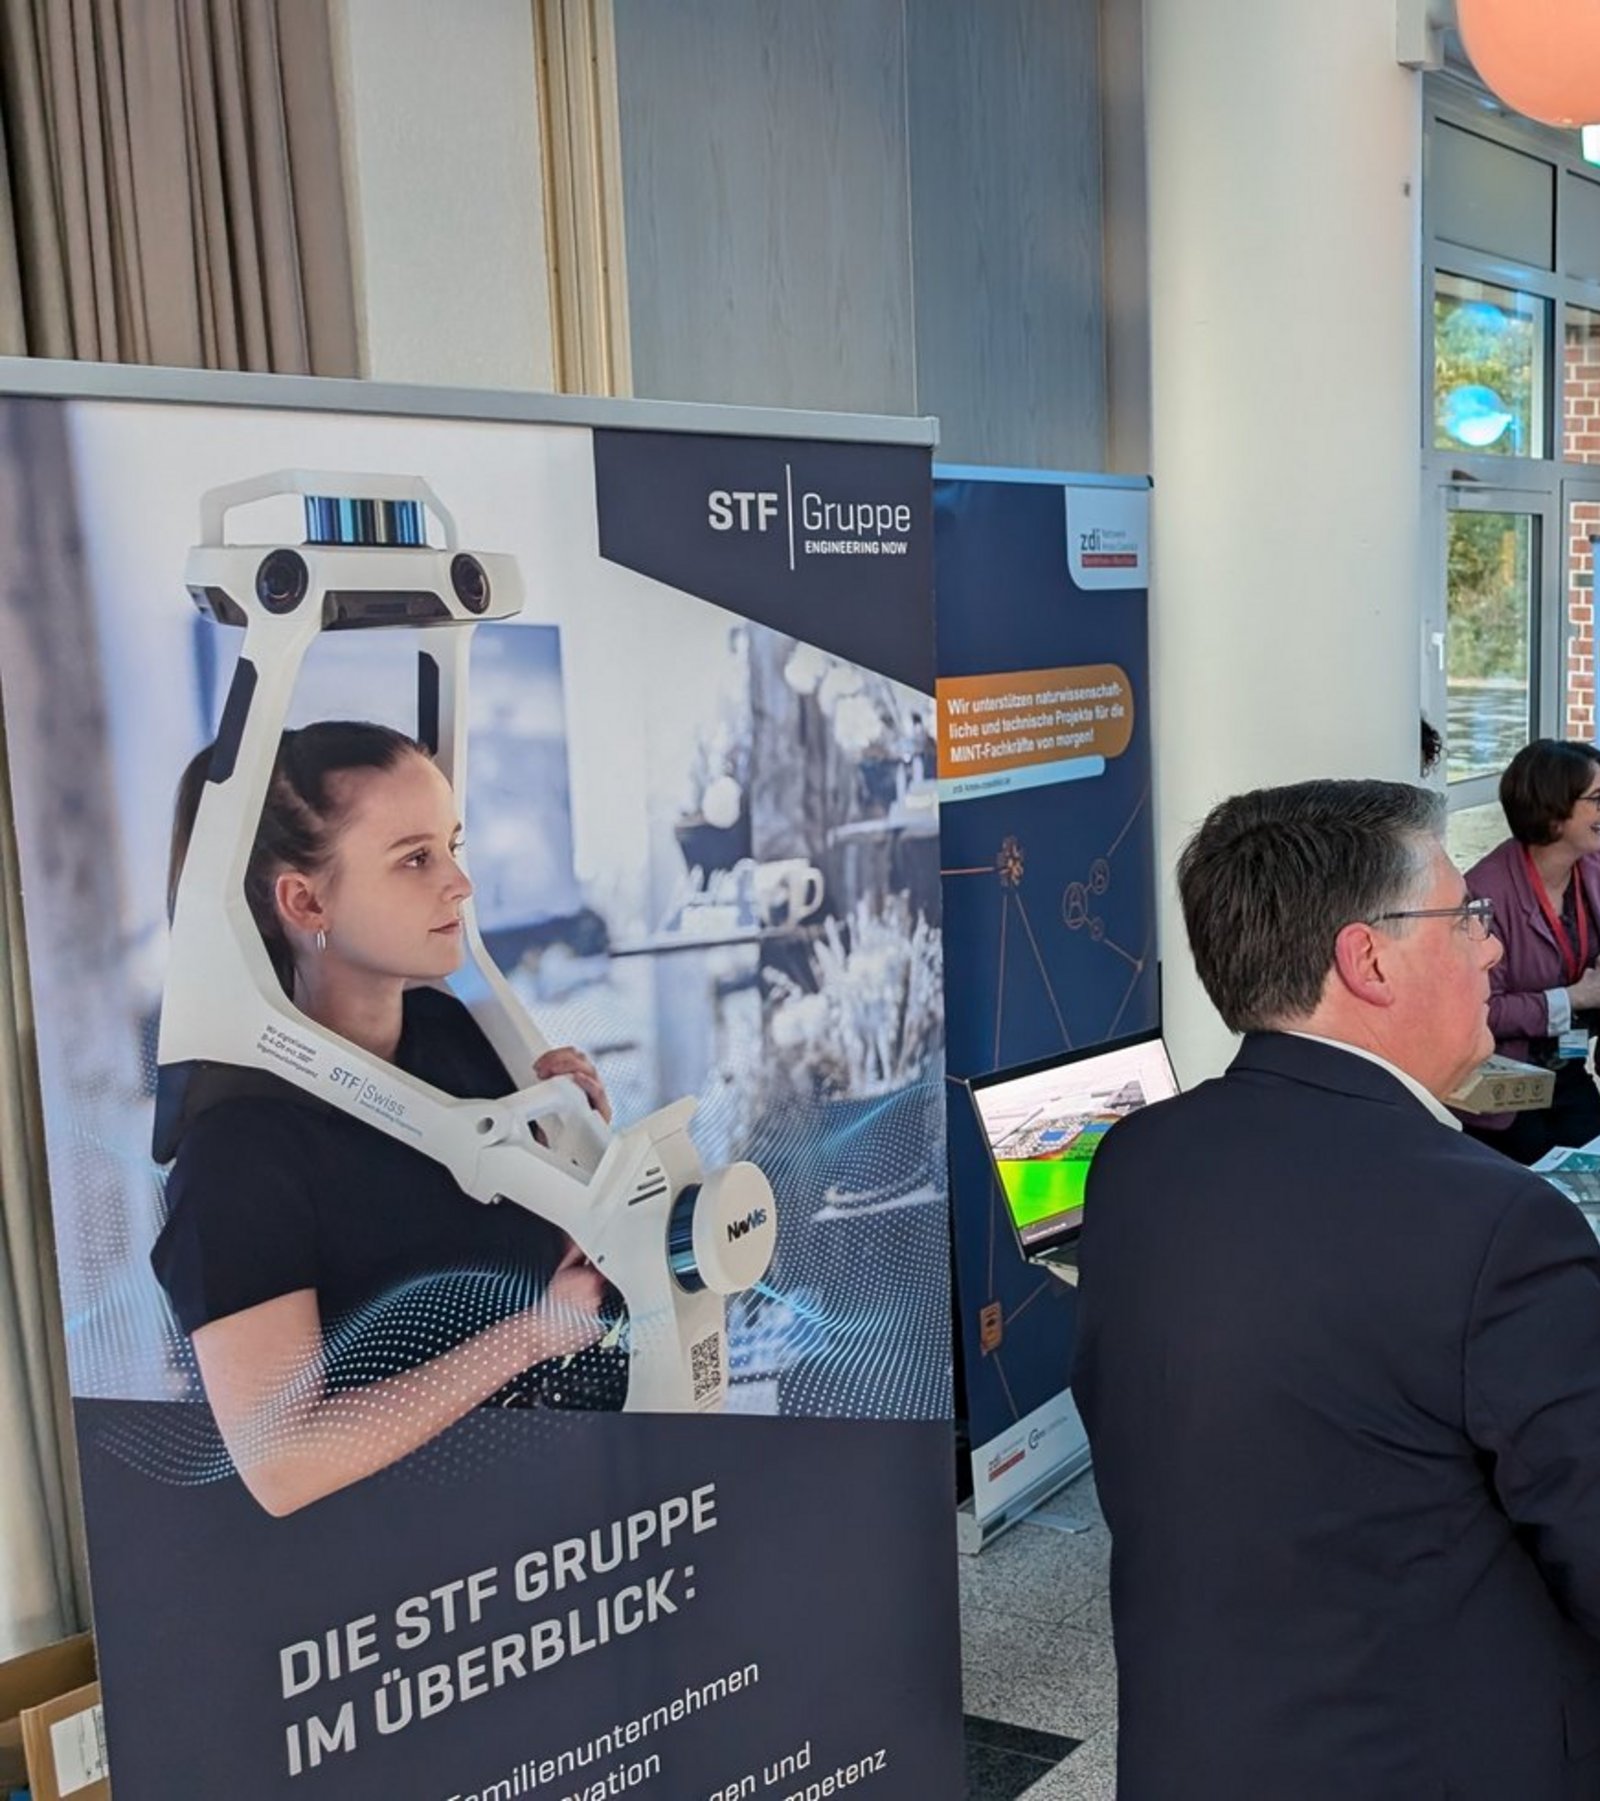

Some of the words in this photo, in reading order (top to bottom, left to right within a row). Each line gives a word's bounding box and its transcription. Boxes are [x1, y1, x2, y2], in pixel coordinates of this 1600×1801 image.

[708, 490, 777, 531] STF
[802, 492, 911, 535] Gruppe
[805, 540, 879, 554] ENGINEERING
[881, 541, 907, 554] NOW
[947, 698, 970, 716] Wir
[972, 692, 1033, 712] unterstützen
[1035, 682, 1123, 706] naturwissenschaft-
[949, 723, 979, 740] liche
[981, 720, 1001, 735] und
[1002, 712, 1054, 733] technische
[1055, 708, 1093, 727] Projekte
[1094, 705, 1108, 720] für
[1110, 703, 1125, 718] die
[951, 737, 1035, 763] MINT-Fachkräfte
[1036, 735, 1055, 750] von
[1056, 729, 1094, 749] morgen!
[329, 1067, 361, 1090] STF
[363, 1084, 406, 1117] Swiss
[280, 1613, 380, 1699] DIE
[395, 1566, 498, 1650] STF
[513, 1483, 718, 1602] GRUPPE
[286, 1701, 356, 1777] IM
[375, 1564, 697, 1735] ÜBERBLICK:
[561, 1754, 661, 1801] vation
[764, 1740, 811, 1786] und
